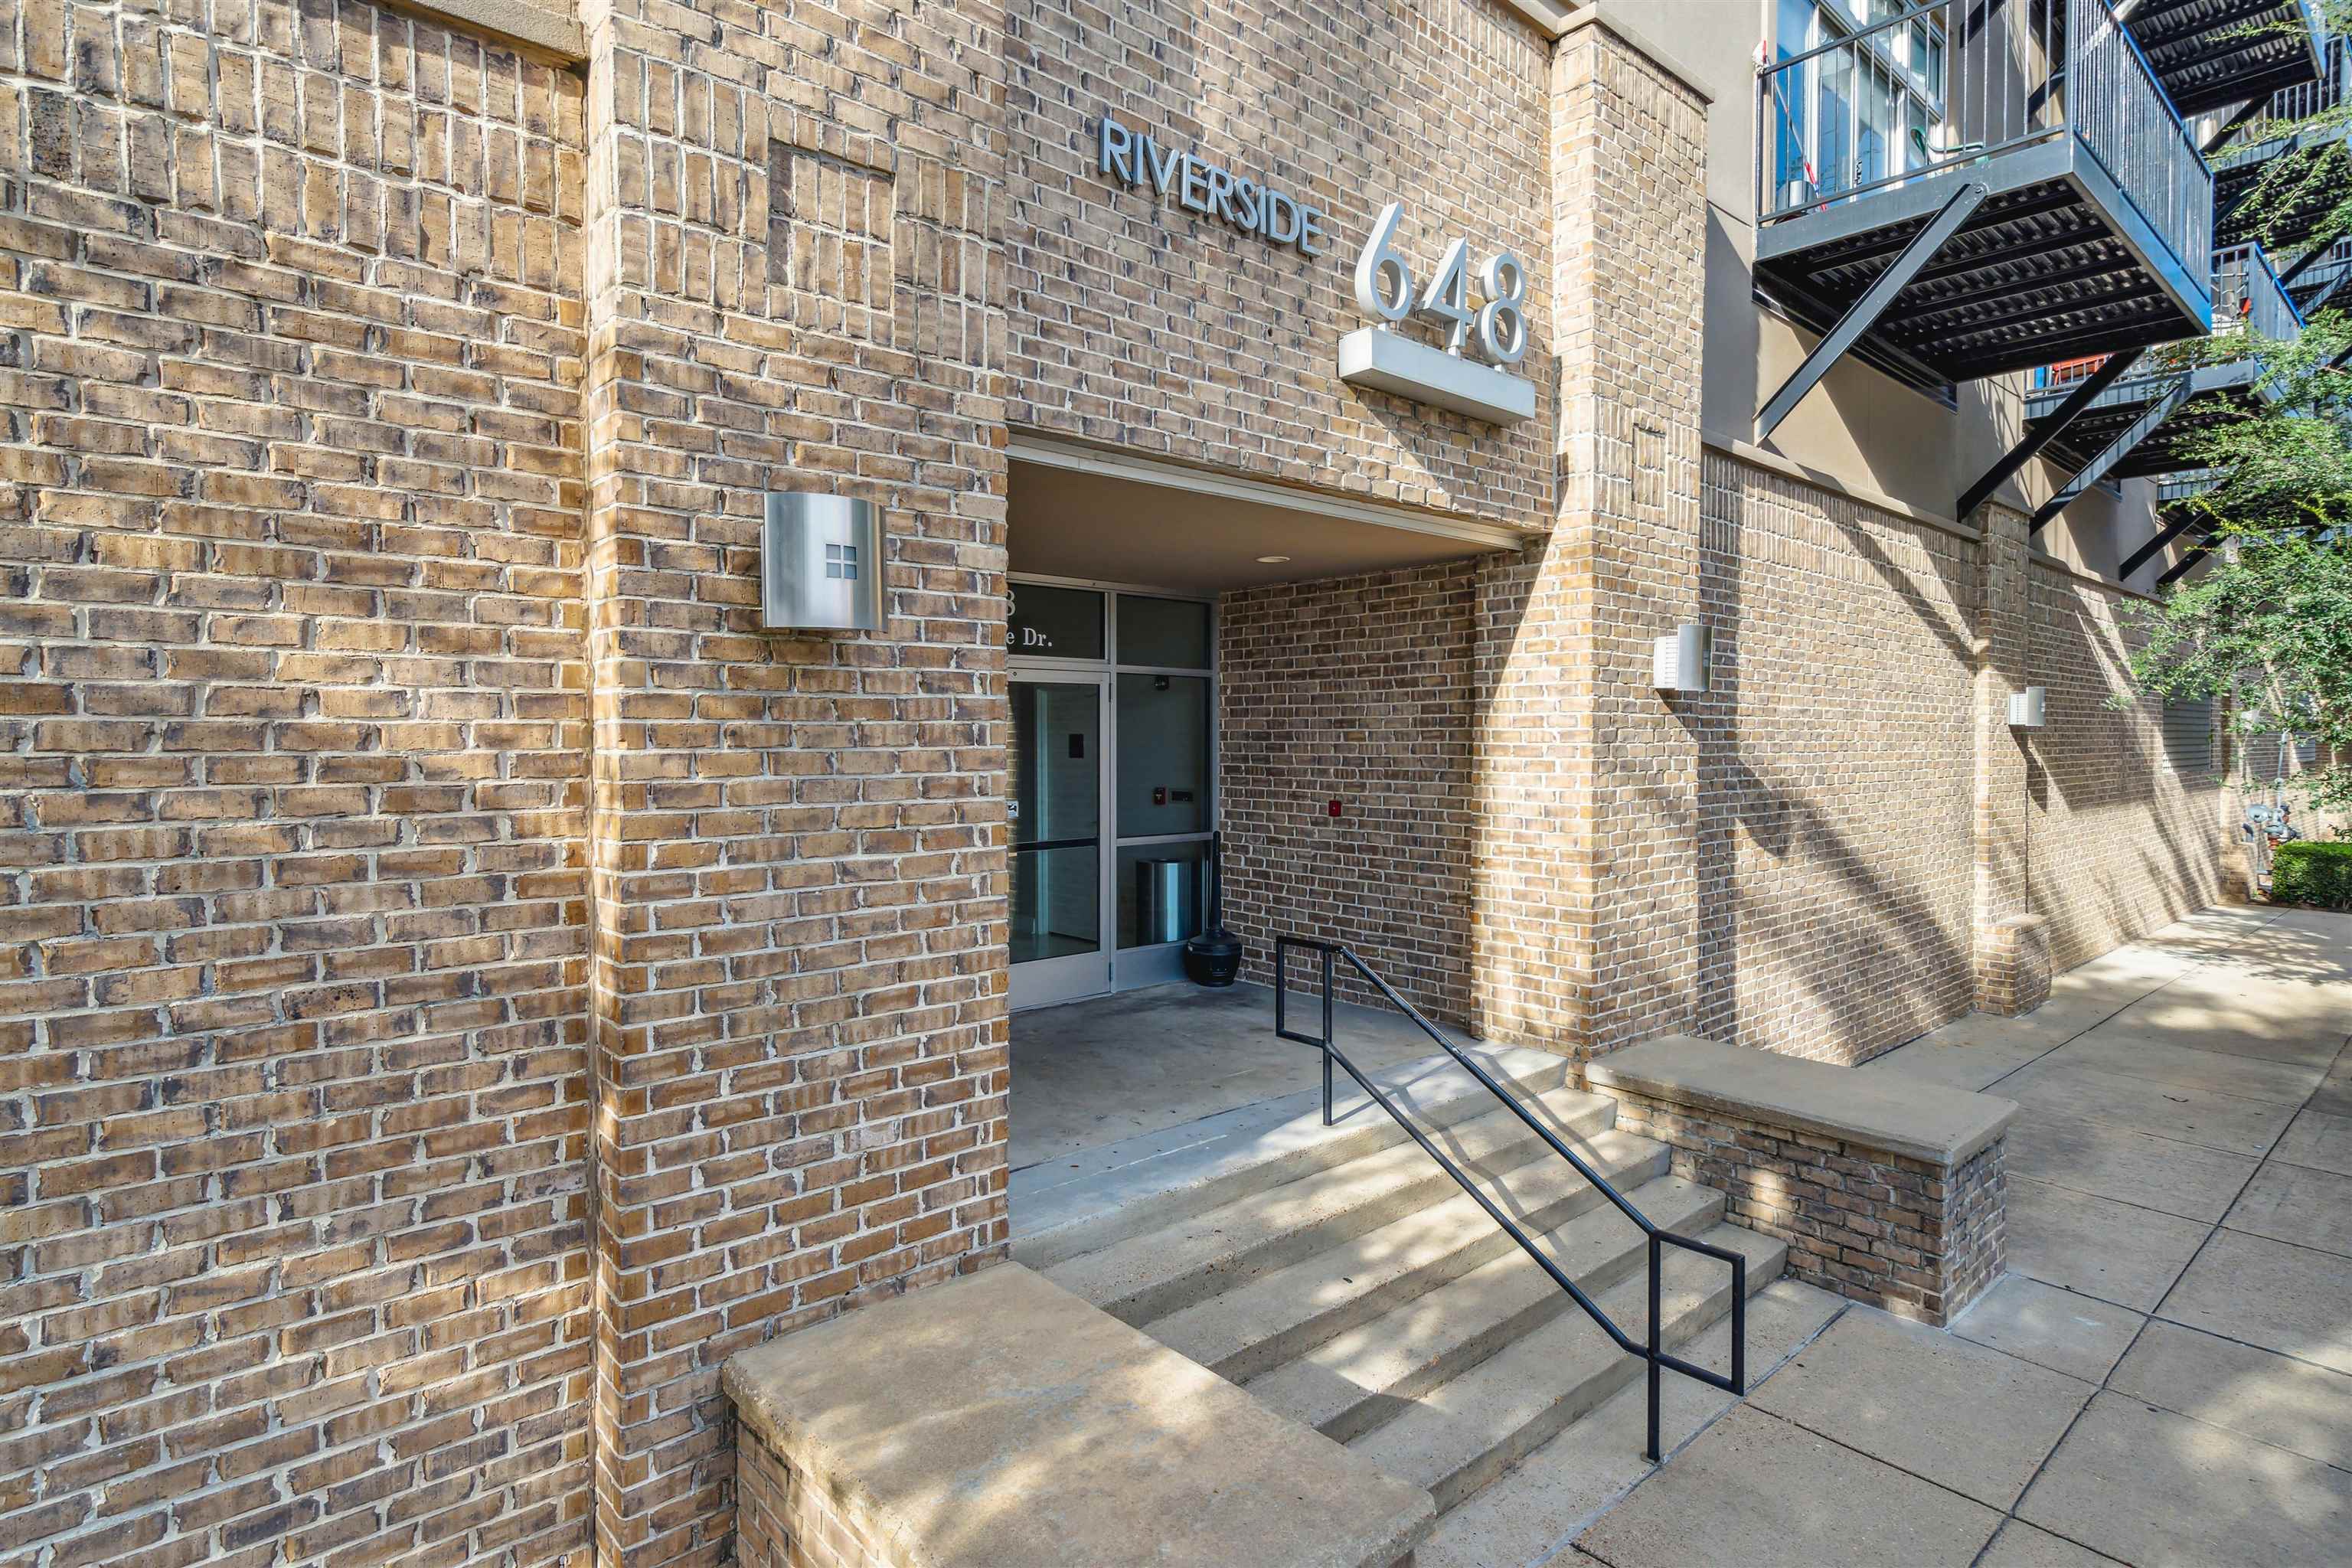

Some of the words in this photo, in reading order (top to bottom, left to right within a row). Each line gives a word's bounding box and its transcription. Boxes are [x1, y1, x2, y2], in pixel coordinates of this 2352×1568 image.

[1099, 117, 1324, 257] RIVERSIDE
[1354, 201, 1527, 364] 648
[1022, 627, 1053, 647] Dr.
